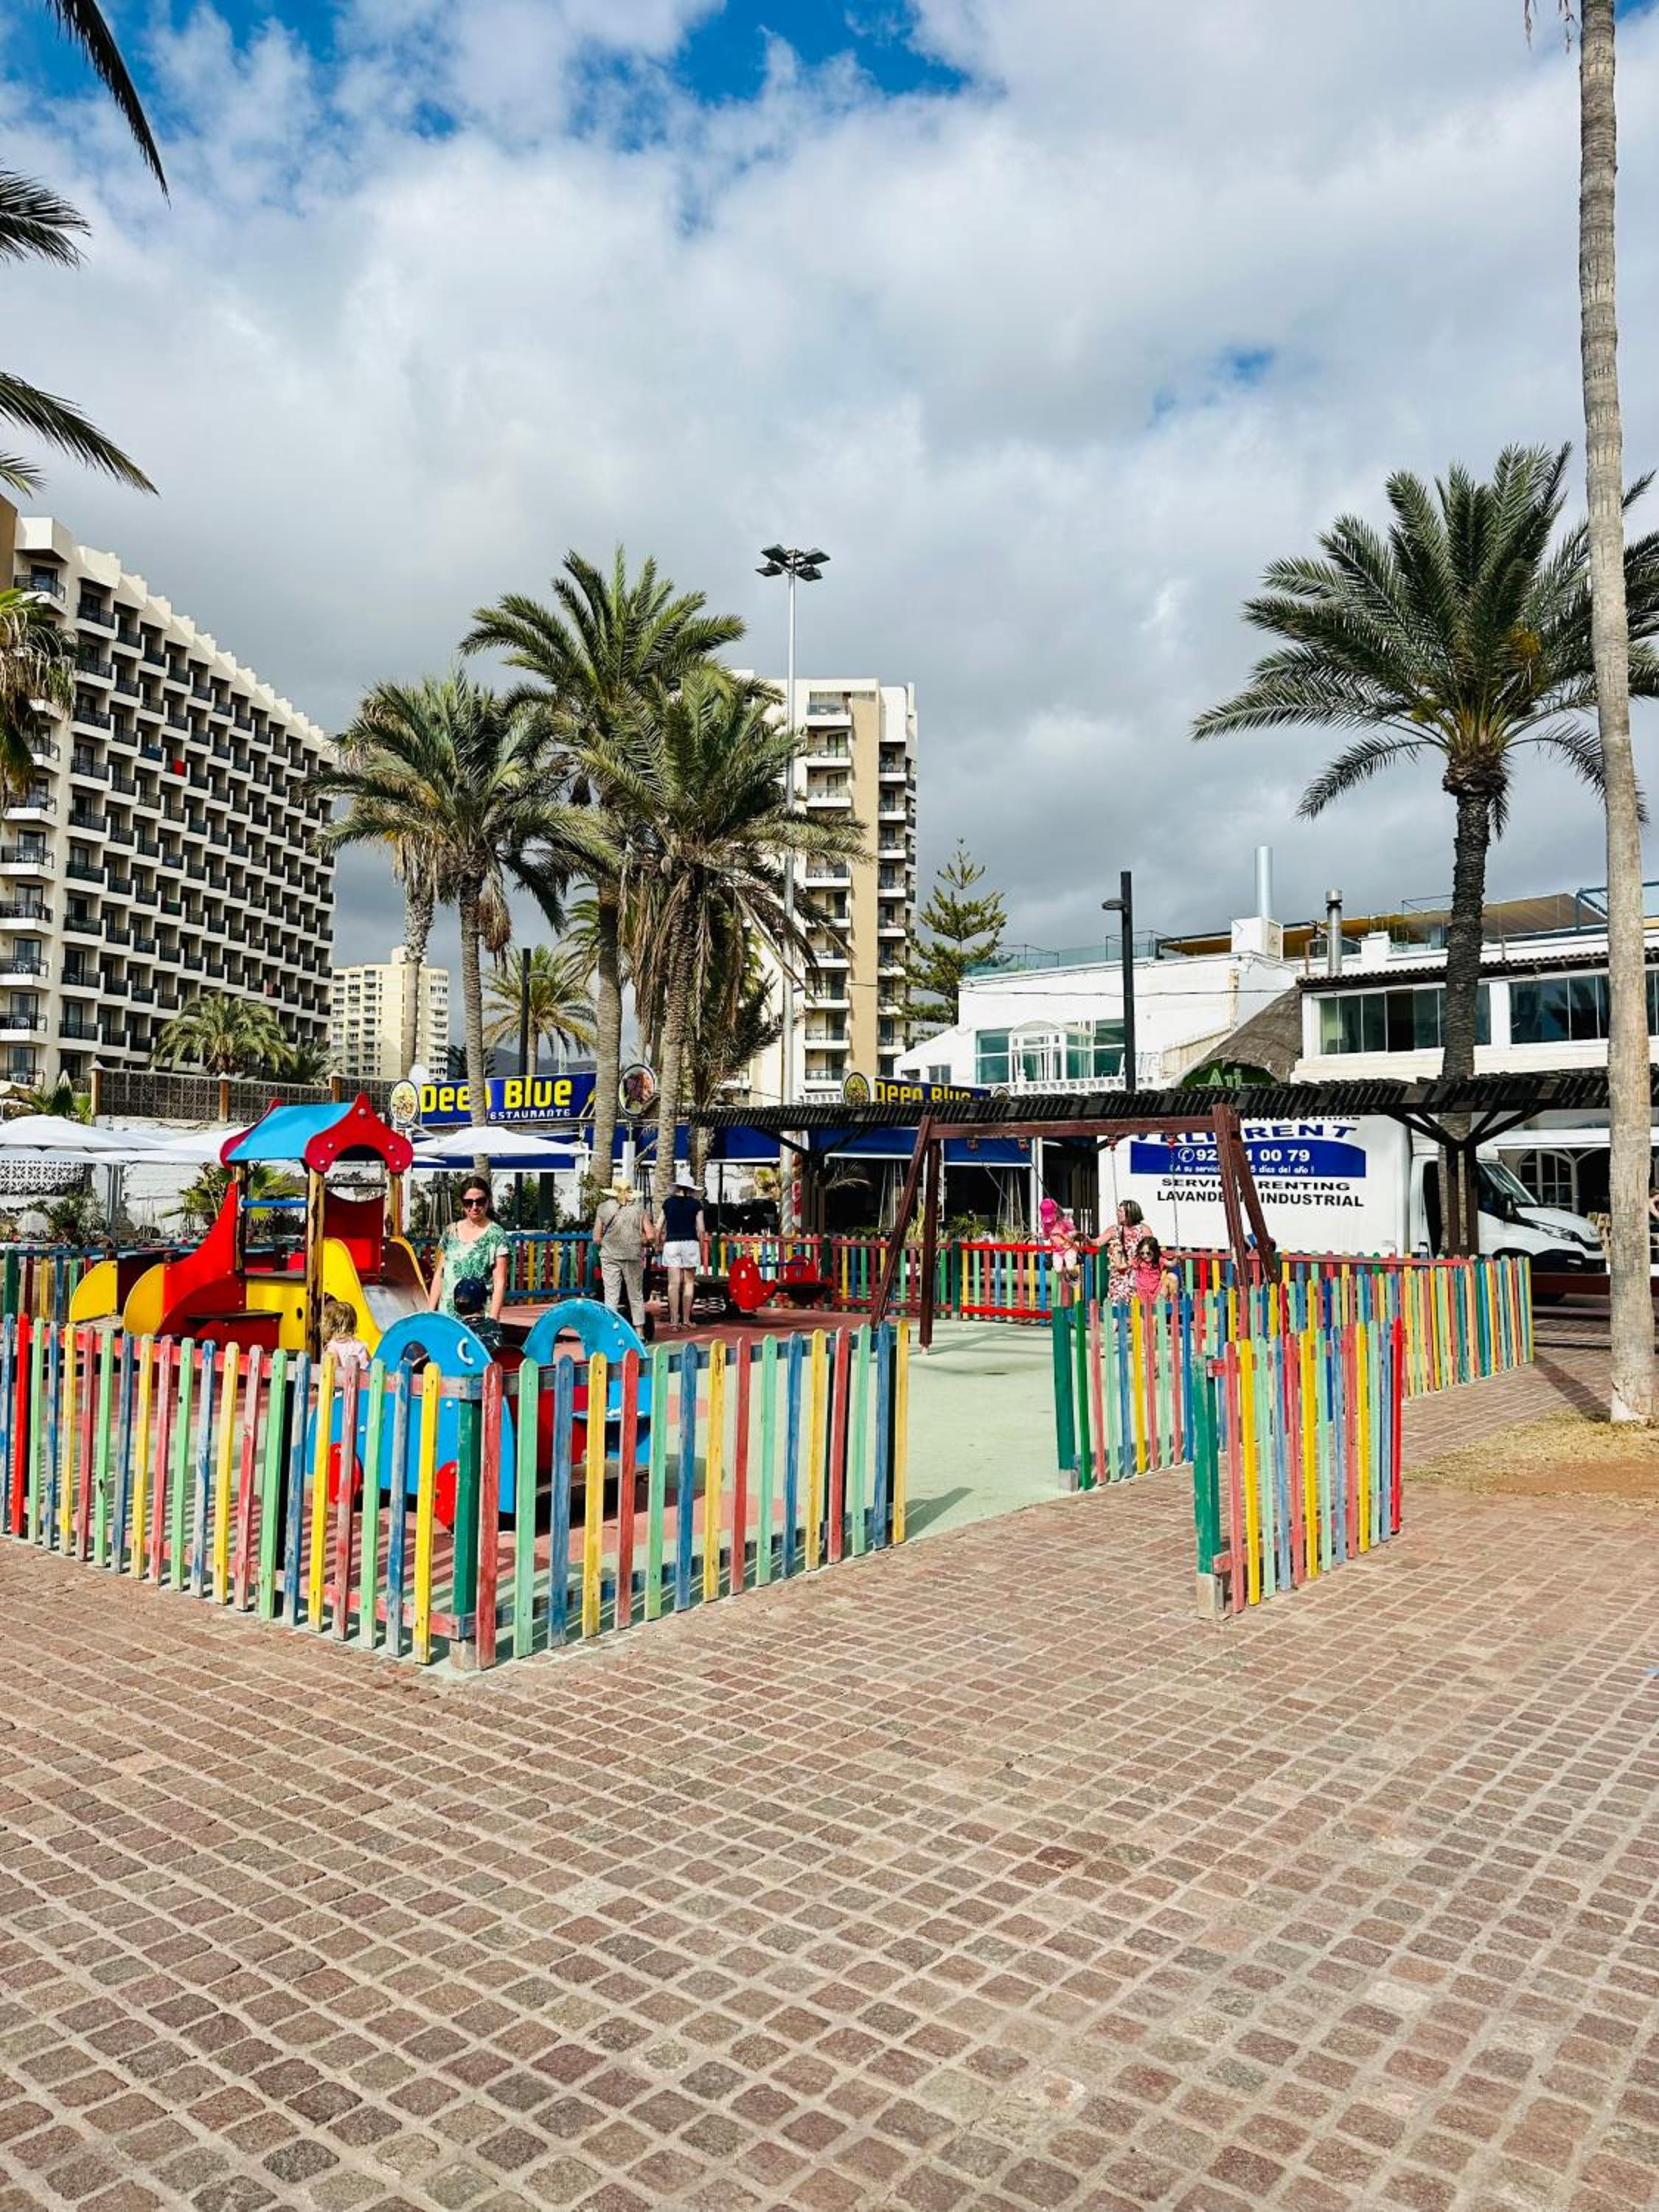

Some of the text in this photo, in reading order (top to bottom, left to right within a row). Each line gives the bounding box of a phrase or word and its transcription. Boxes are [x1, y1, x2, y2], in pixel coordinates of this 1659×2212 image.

[504, 1075, 572, 1110] Blue
[488, 1109, 571, 1120] ESTAURANTE
[1260, 1149, 1282, 1161] 00
[1287, 1149, 1310, 1162] 79
[1195, 1165, 1221, 1173] servici
[1259, 1181, 1350, 1191] RENTING
[1261, 1193, 1364, 1207] INDUSTRIAL
